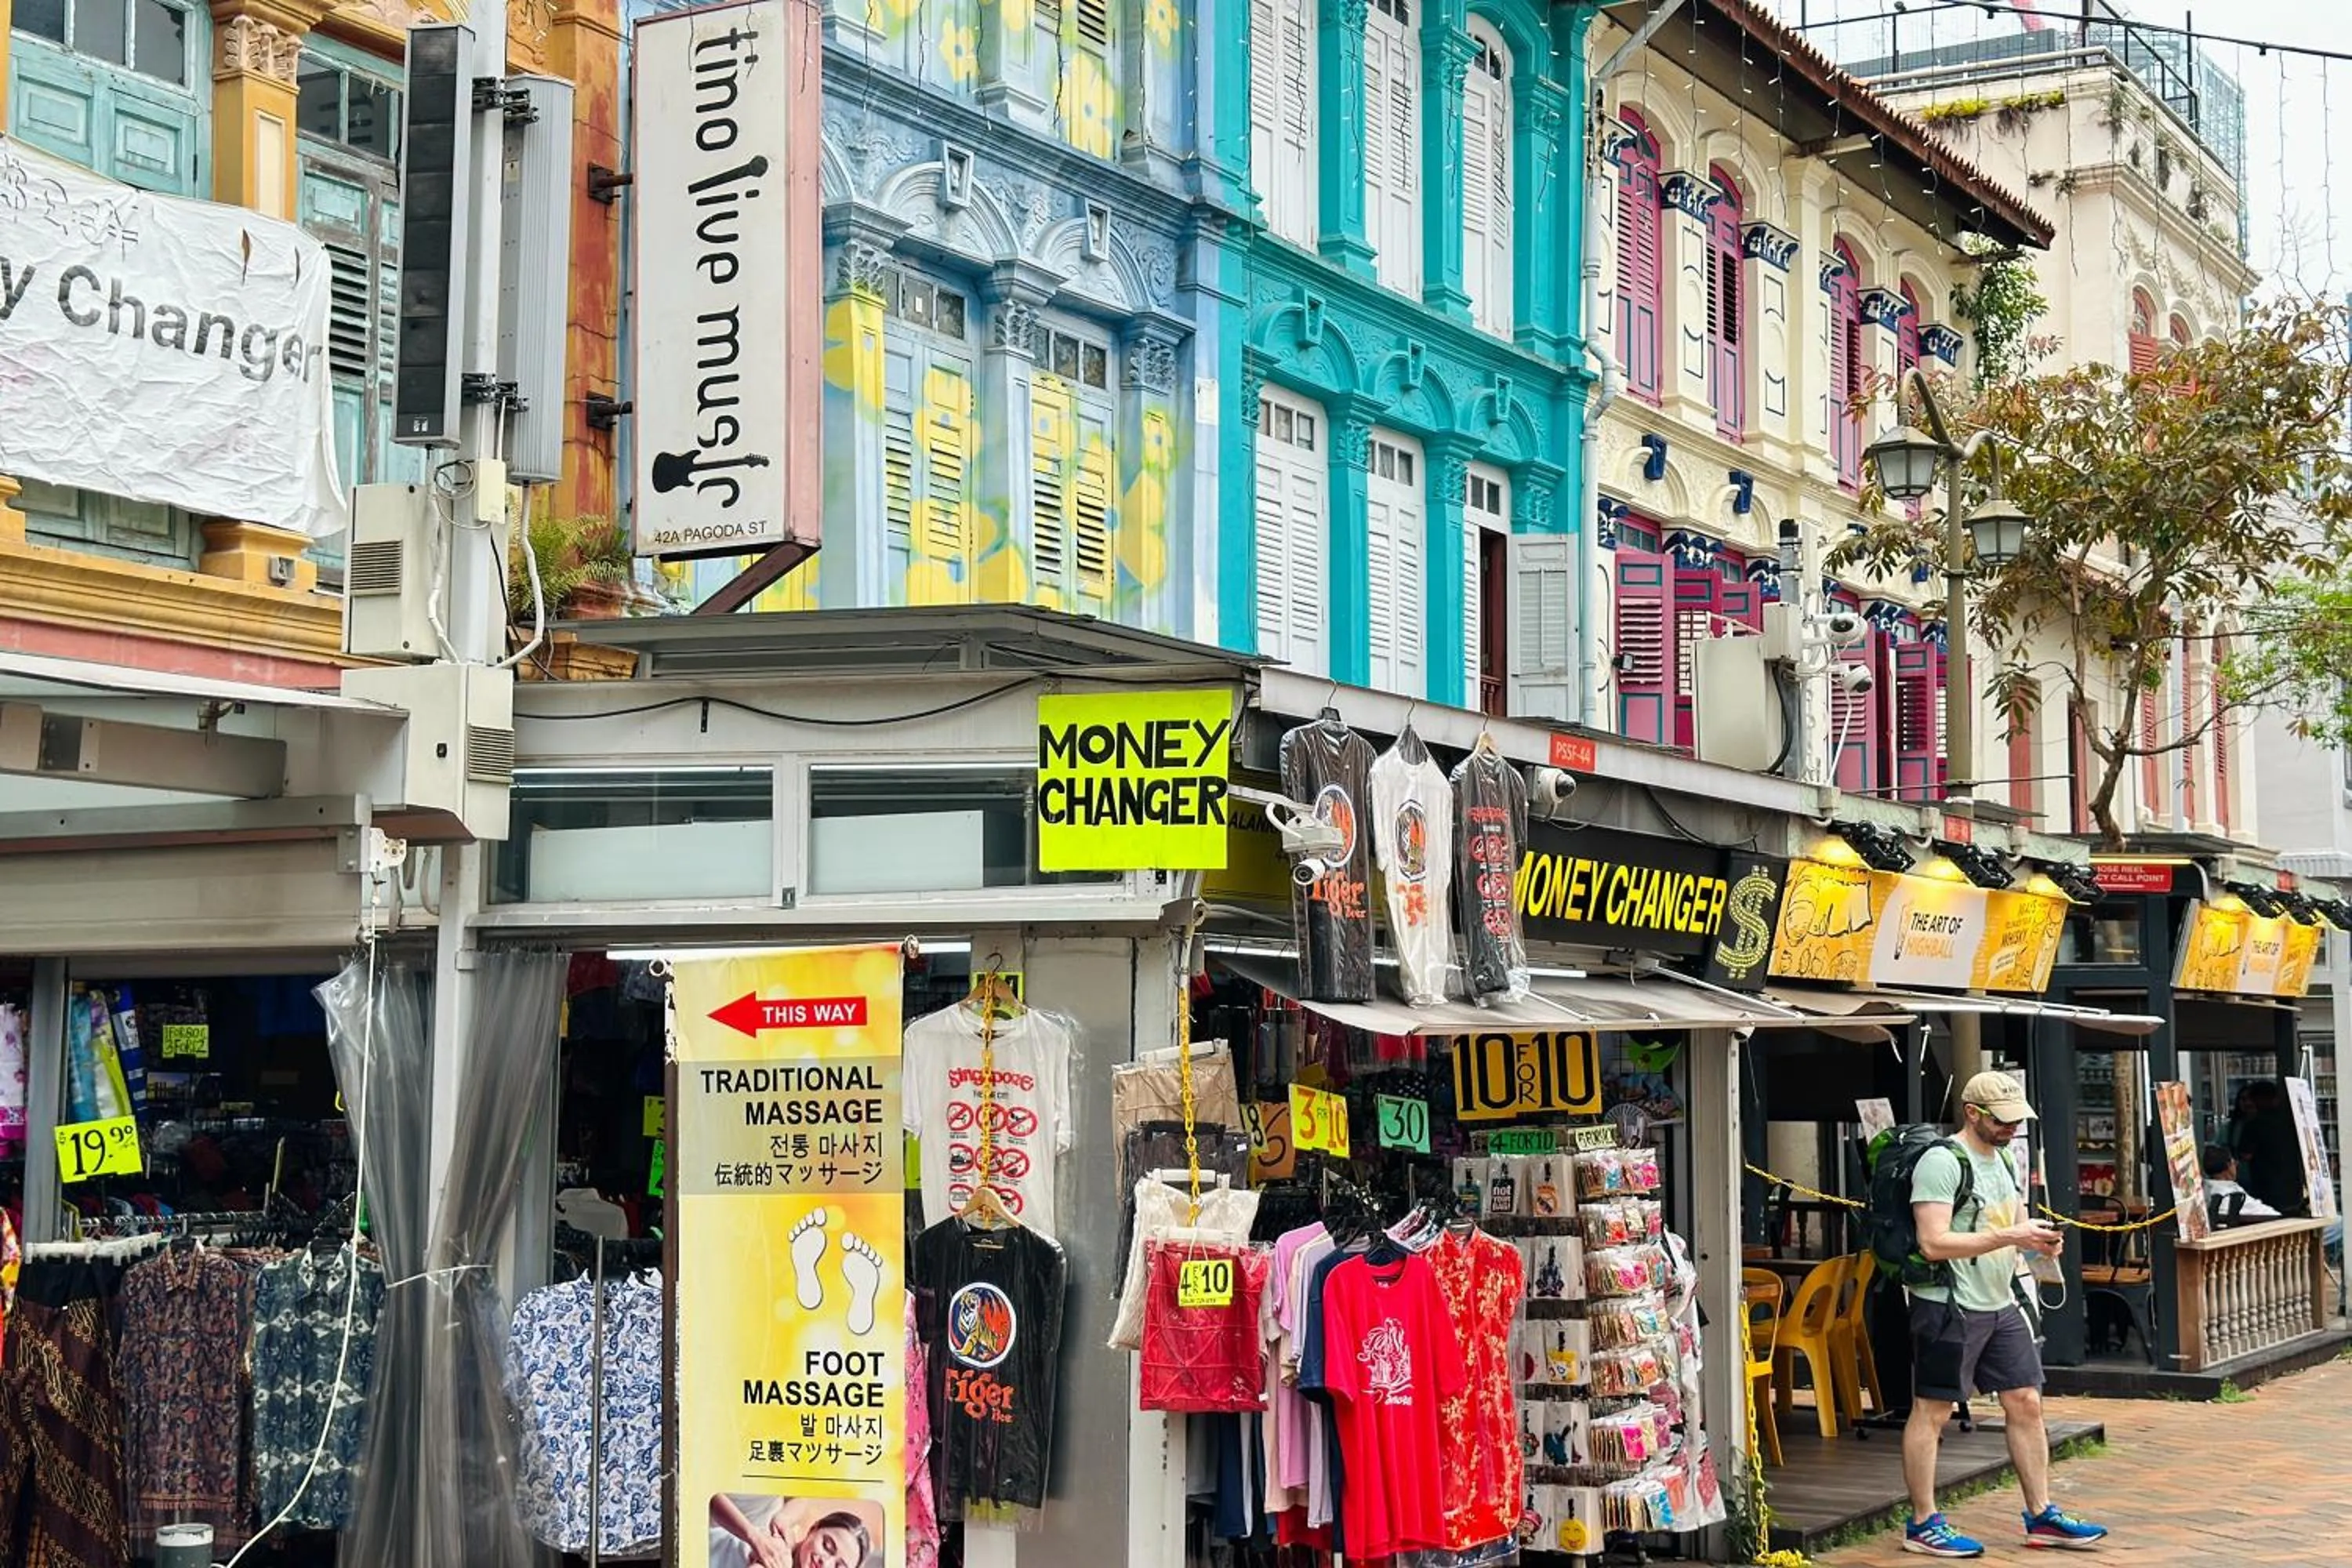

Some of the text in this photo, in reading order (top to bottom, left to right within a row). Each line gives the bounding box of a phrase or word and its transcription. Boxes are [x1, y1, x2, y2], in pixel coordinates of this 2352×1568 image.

[58, 265, 322, 383] Changer
[654, 520, 768, 544] 42A PAGODA ST
[1039, 718, 1231, 770] MONEY
[1039, 775, 1229, 826] CHANGER
[1514, 851, 1727, 935] MONEY CHANGER
[1911, 912, 1964, 935] THE ART OF
[763, 1003, 857, 1023] THIS WAY
[700, 1065, 884, 1094] TRADITIONAL
[1454, 1031, 1595, 1111] 10 FOR 10
[745, 1098, 883, 1126] MASSAGE
[1383, 1098, 1425, 1144] 30
[770, 1131, 883, 1159] 전통 마사지
[1490, 1133, 1508, 1152] 4
[714, 1161, 883, 1186] 伝統的マッサージ
[1201, 1261, 1229, 1294] 10
[805, 1351, 885, 1376] FOOT
[743, 1380, 884, 1407] MASSAGE
[800, 1413, 882, 1439] 발 마사지
